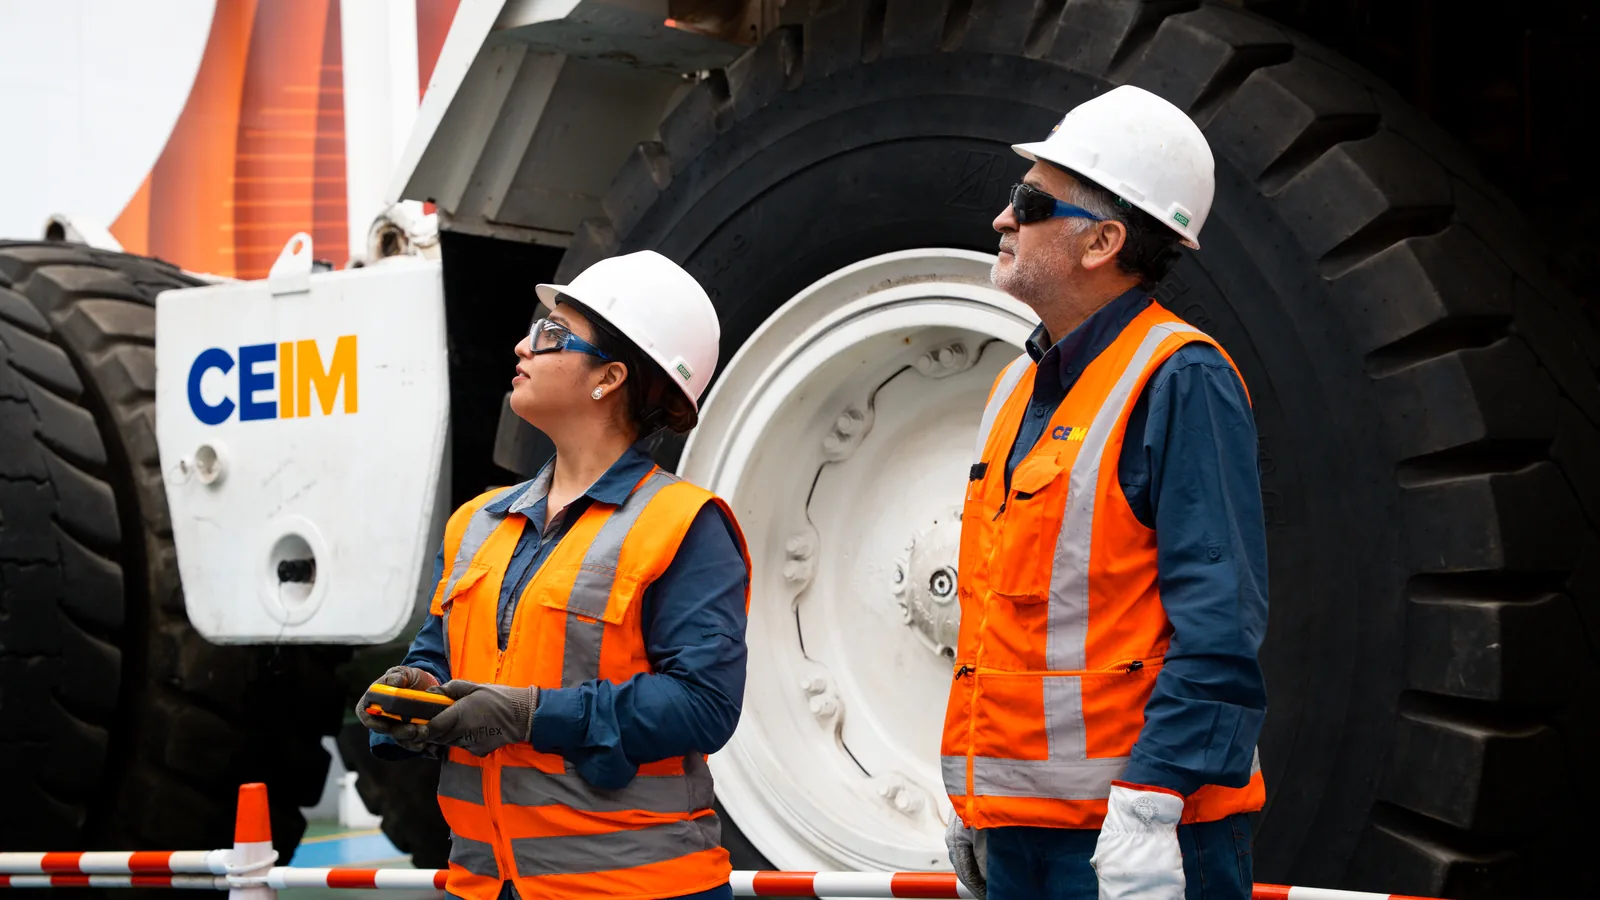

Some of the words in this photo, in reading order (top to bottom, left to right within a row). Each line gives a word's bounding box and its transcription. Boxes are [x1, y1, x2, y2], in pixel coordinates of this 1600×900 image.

[1174, 213, 1188, 226] MSA
[187, 334, 358, 426] CEIM
[1052, 425, 1088, 442] CEIM
[464, 726, 503, 744] HyFlex
